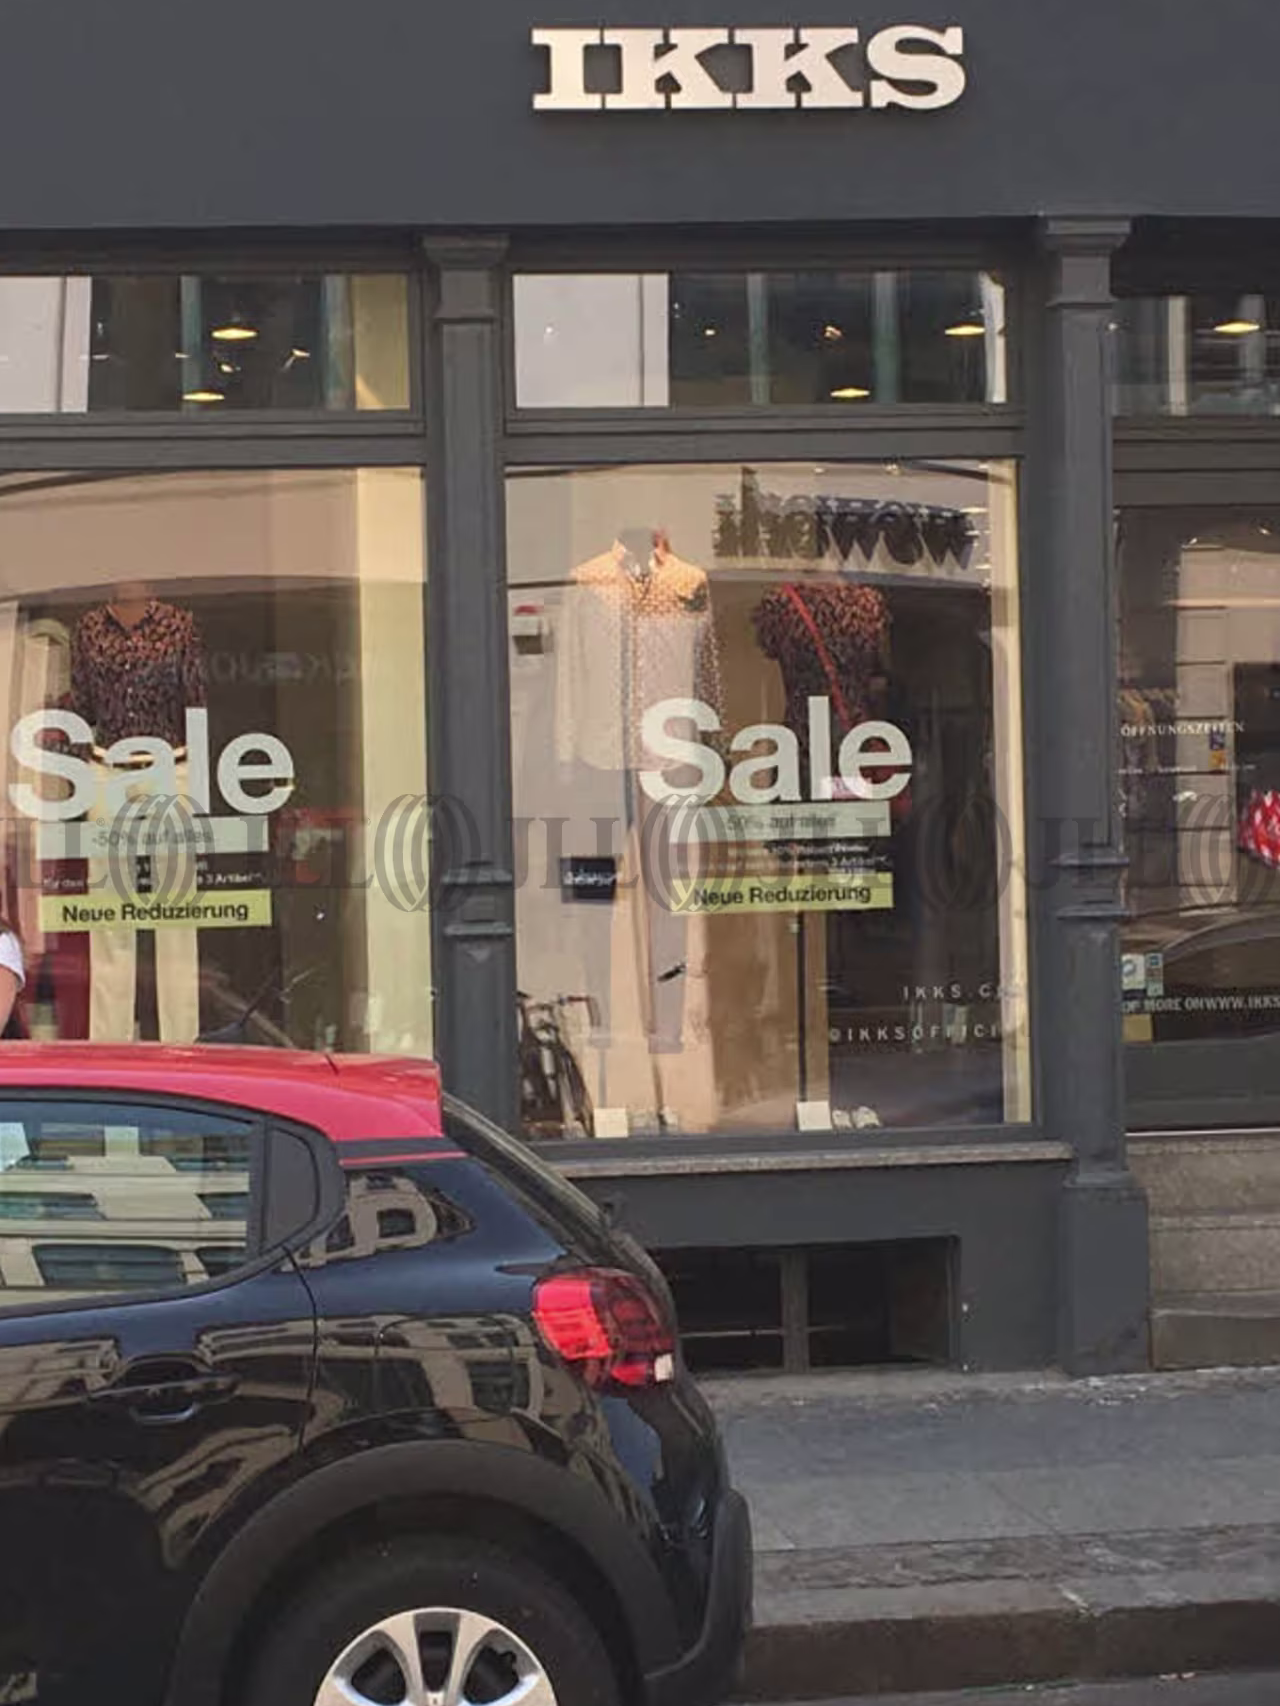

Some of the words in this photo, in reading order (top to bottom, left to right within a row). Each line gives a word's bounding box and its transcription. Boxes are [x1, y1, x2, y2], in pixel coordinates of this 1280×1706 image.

[531, 25, 966, 110] IKKS
[8, 707, 295, 821] Sale
[639, 696, 912, 807] Sale
[62, 904, 115, 923] Neue
[122, 901, 249, 921] Reduzierung
[694, 888, 743, 905] Neue
[750, 884, 871, 904] Reduzierung
